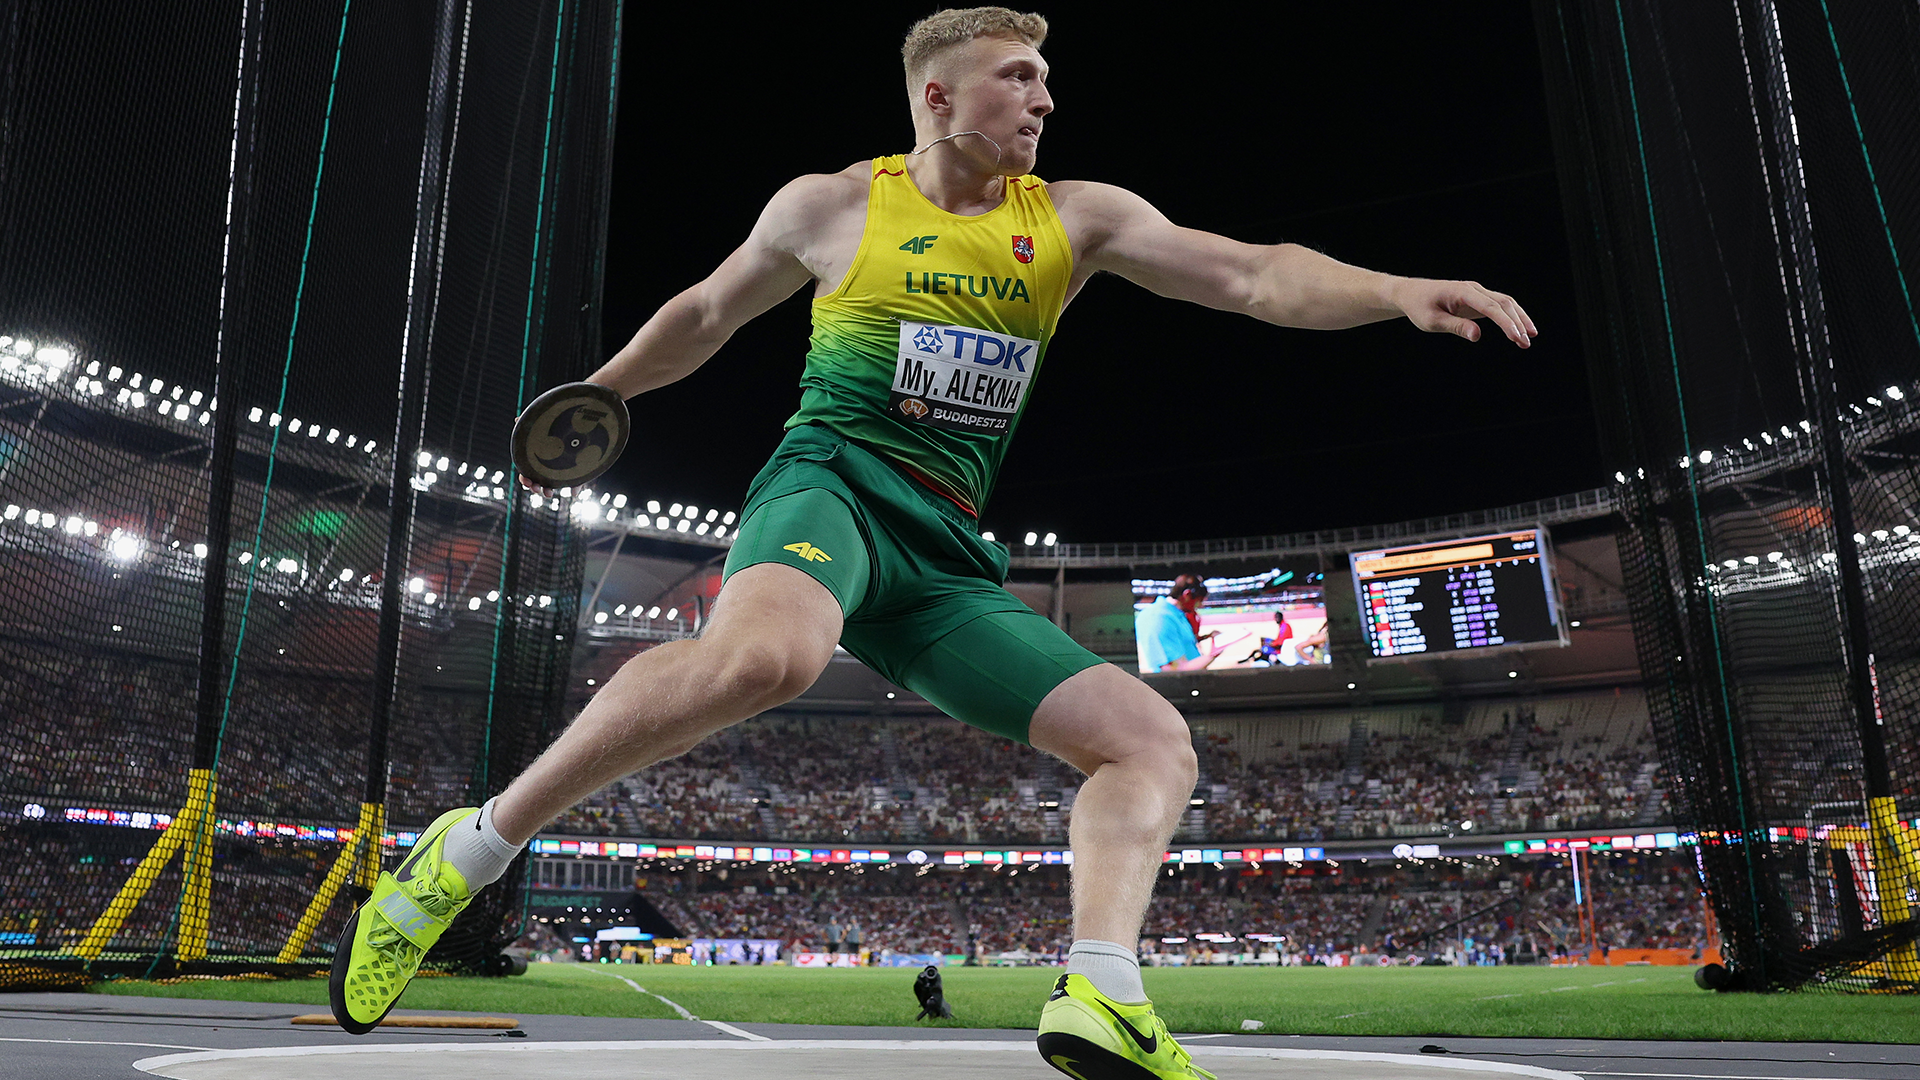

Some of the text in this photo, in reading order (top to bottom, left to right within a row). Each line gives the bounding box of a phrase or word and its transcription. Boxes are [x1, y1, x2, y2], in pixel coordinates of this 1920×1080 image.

[899, 236, 938, 254] 4F
[906, 272, 1030, 303] LIETUVA
[944, 329, 1032, 373] TDK
[900, 358, 1021, 409] My. ALEKNA
[783, 542, 833, 563] 4F
[376, 890, 435, 937] NIKE
